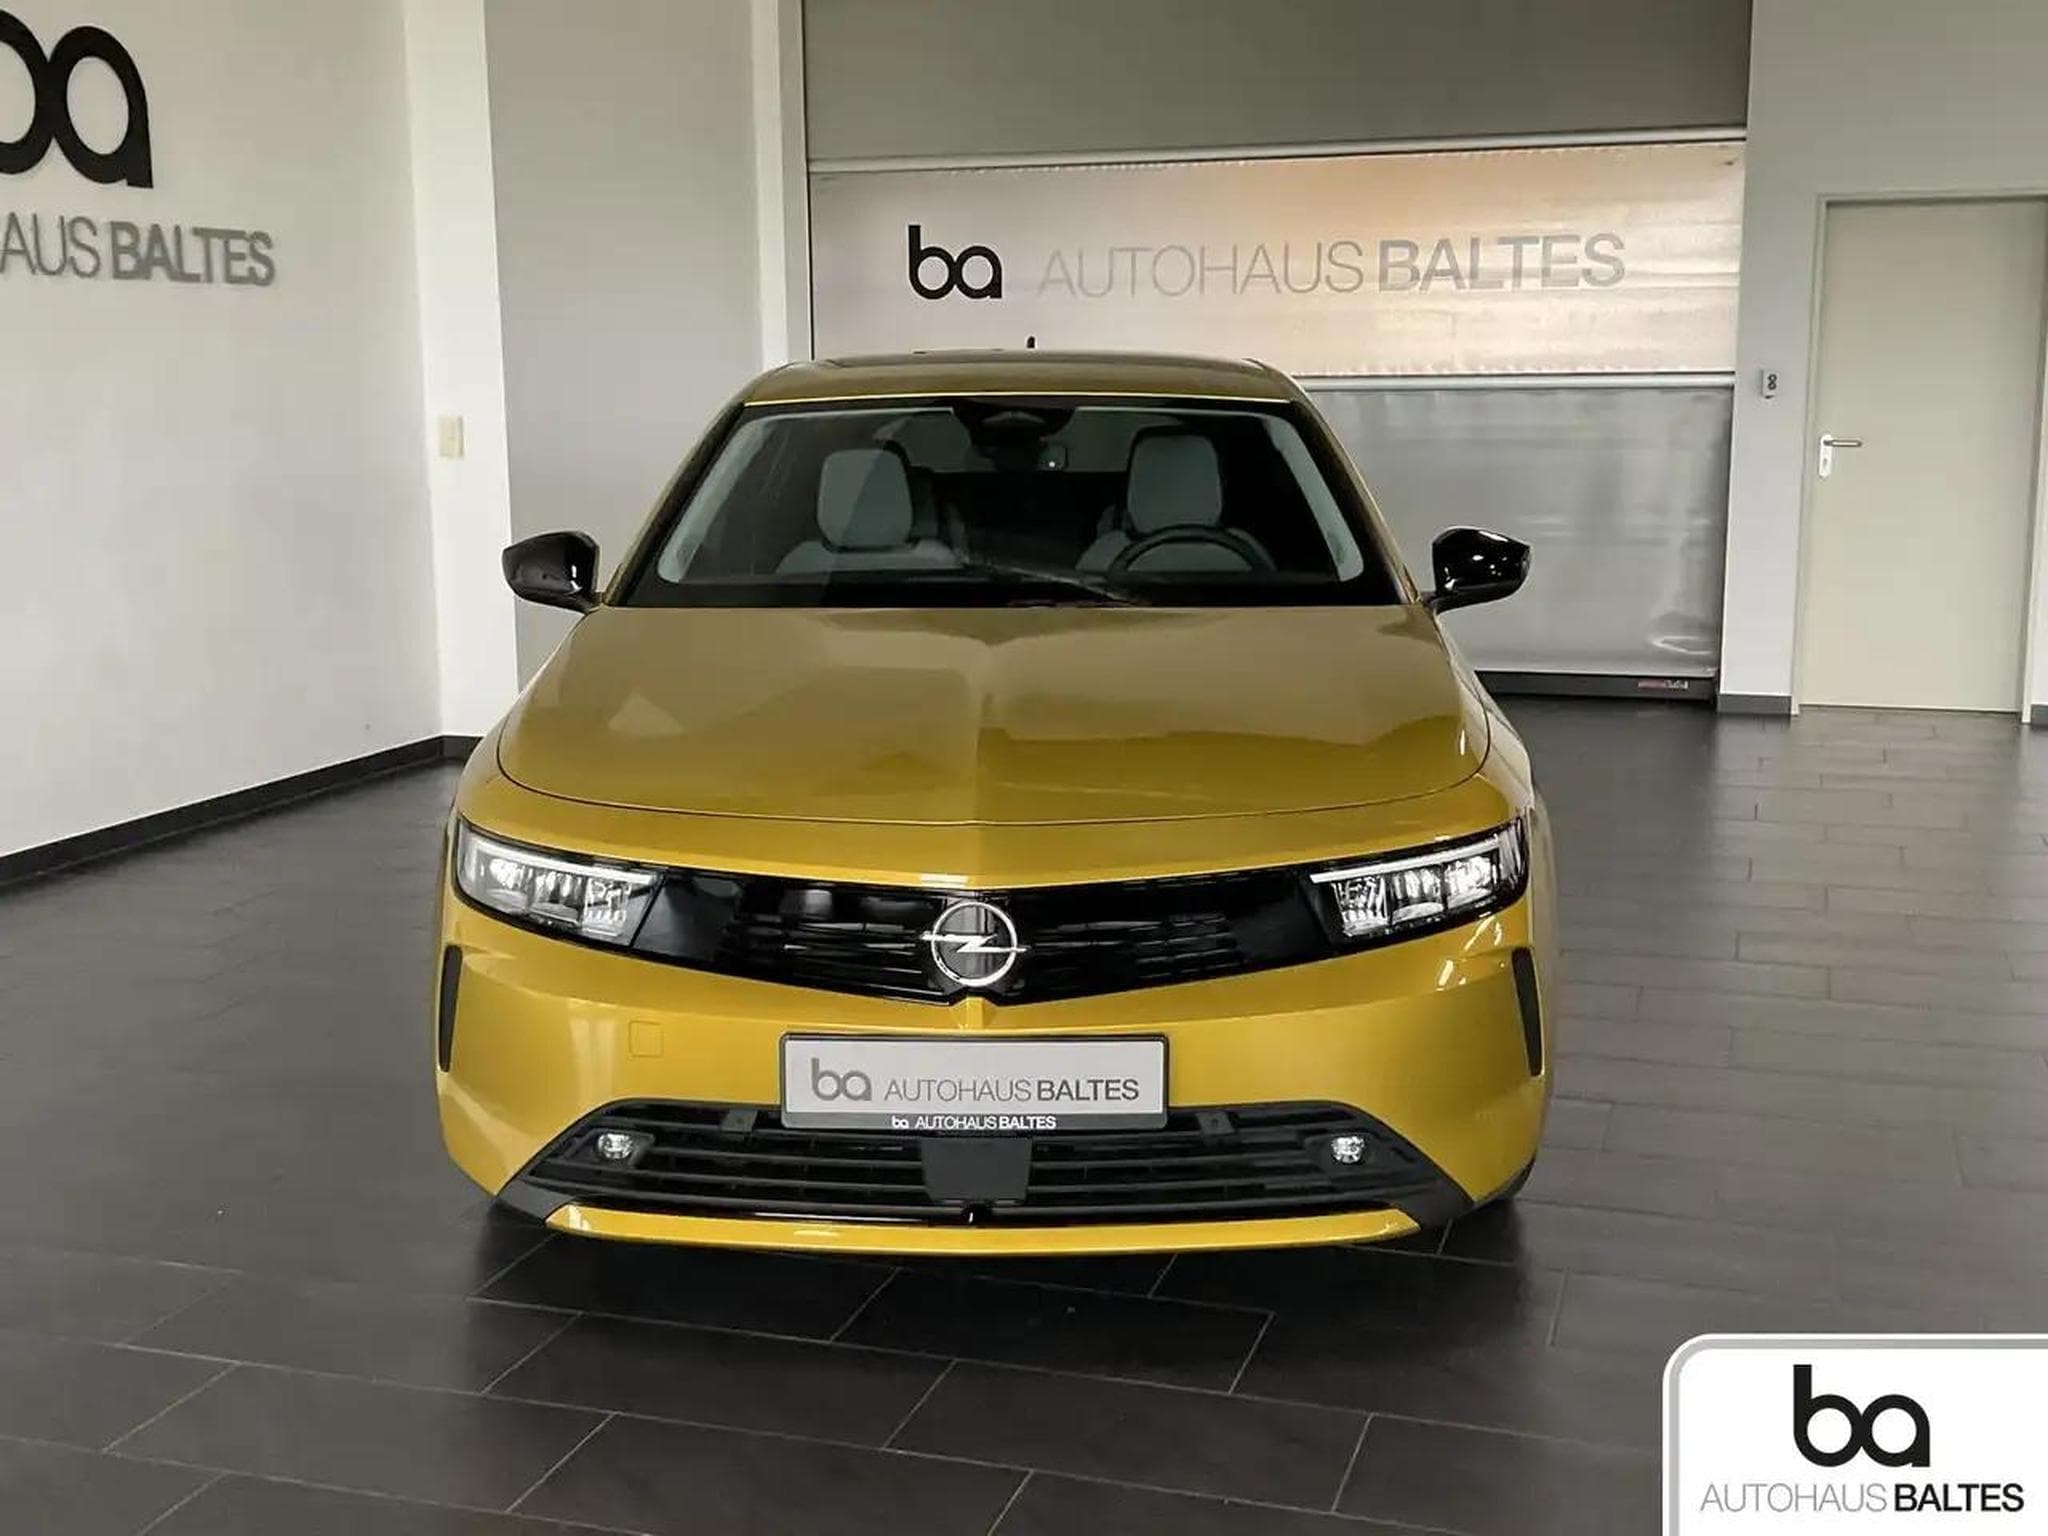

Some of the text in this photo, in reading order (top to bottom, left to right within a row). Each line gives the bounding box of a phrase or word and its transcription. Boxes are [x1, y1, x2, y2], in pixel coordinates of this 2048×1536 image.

[110, 221, 275, 286] BALTES
[908, 224, 1626, 299] ba AUTOHAUS BALTES
[811, 1057, 1139, 1101] ba AUTOHAUS BALTES
[892, 1115, 1057, 1130] ba AUTOHAUS BALTES
